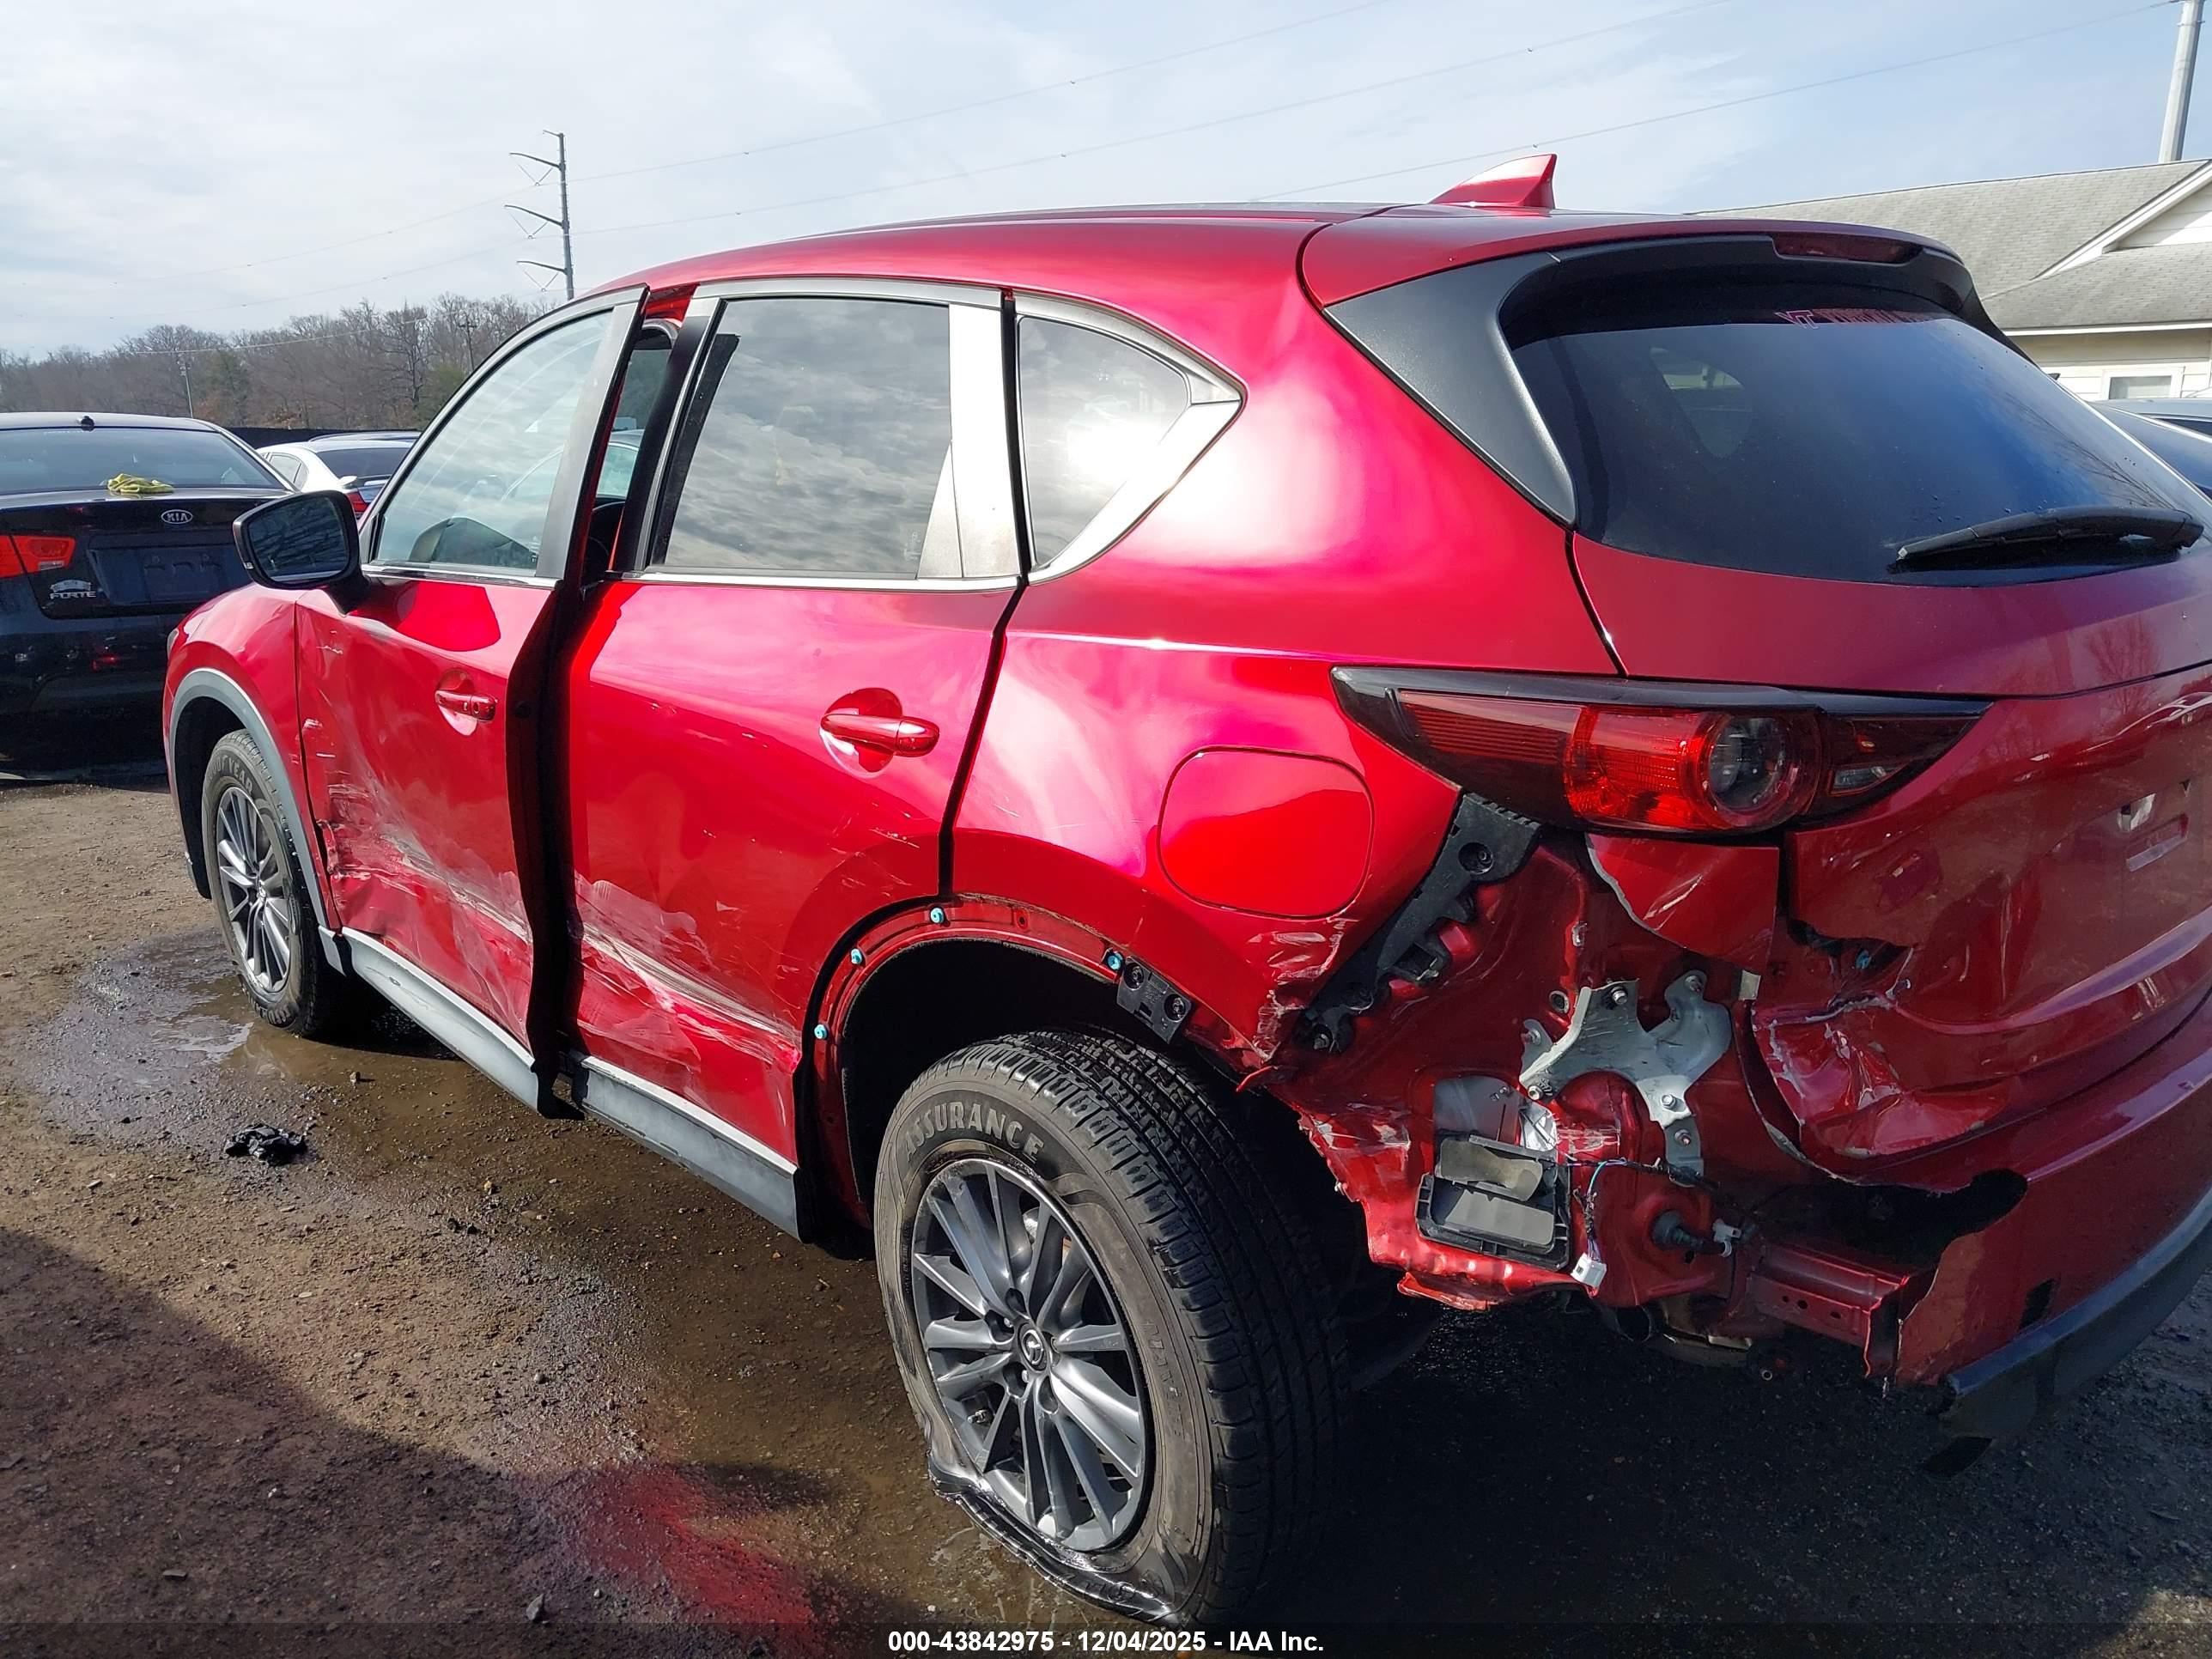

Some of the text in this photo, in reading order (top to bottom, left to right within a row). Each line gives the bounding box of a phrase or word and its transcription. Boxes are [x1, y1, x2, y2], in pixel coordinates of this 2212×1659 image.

[167, 513, 189, 522] KIA
[49, 591, 97, 600] FORTE
[903, 1101, 1045, 1164] ASSURANCE
